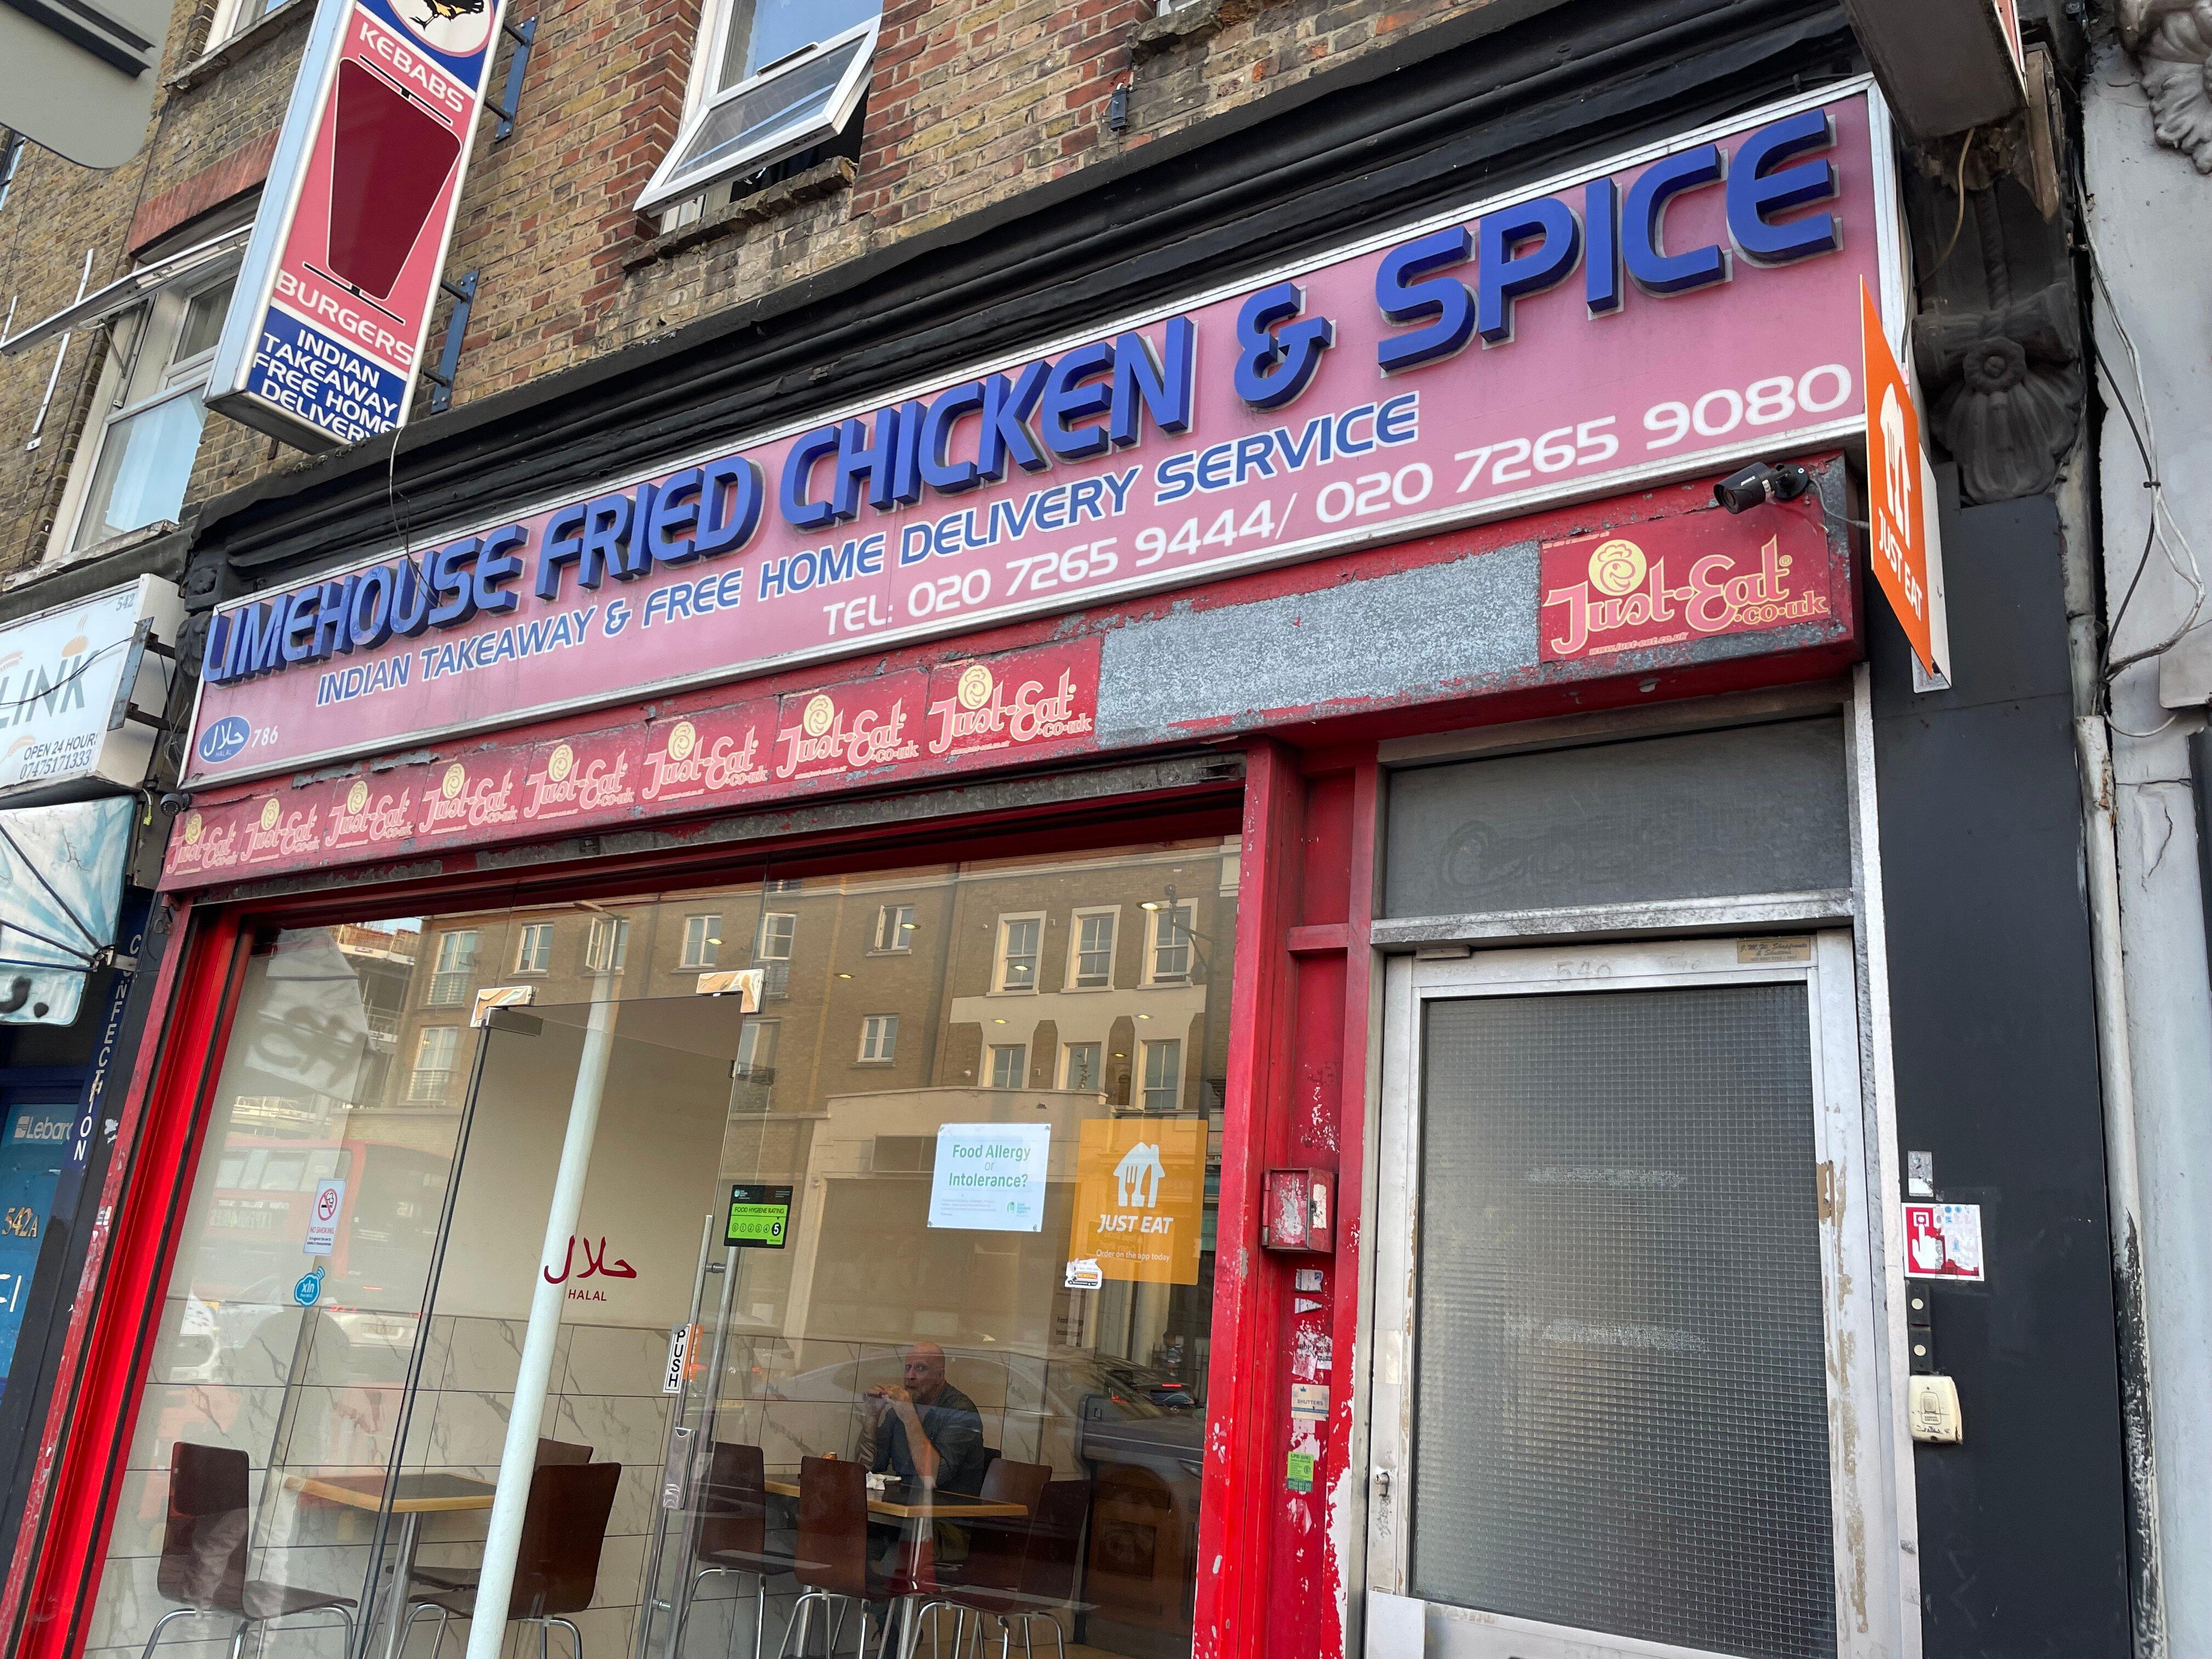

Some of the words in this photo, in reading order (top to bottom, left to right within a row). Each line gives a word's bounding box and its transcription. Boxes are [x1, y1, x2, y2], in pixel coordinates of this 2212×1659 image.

[359, 21, 464, 113] KEBABS
[275, 269, 414, 365] BURGERS
[297, 329, 380, 388] INDIAN
[264, 331, 398, 418] TAKEAWAY
[202, 524, 529, 684] LIMEHOUSE
[536, 456, 764, 600] FRIED
[780, 315, 1195, 530] CHICKEN
[1234, 281, 1334, 411] &
[1375, 109, 1839, 374] SPICE
[252, 356, 318, 399] FREE
[325, 390, 396, 433] HOME
[822, 598, 893, 636] TEL:
[907, 568, 990, 617] 020
[1006, 542, 1118, 596] 7265
[1316, 462, 1433, 524] 020
[1454, 416, 1618, 494] 7265
[1644, 363, 1852, 450] 9080
[316, 662, 410, 706] INDIAN
[421, 606, 596, 680] TAKEAWAY
[604, 599, 631, 637] &
[641, 568, 743, 629] FREE
[758, 533, 884, 602] HOME
[899, 465, 1143, 569] DELIVERY
[1154, 391, 1420, 505] SERVICE
[1878, 507, 1903, 583] JUST
[1905, 571, 1923, 621] EAT
[116, 593, 135, 611] 542
[24, 744, 49, 760] OPEN
[52, 741, 63, 754] 24
[204, 721, 245, 757] حلال
[252, 725, 278, 748] 786
[20, 749, 92, 780] 07475171333
[215, 749, 232, 758] HALAL
[1556, 961, 1611, 979] 540
[74, 934, 142, 1161] CNFECTION
[952, 1144, 983, 1158] Food
[985, 1145, 1030, 1161] Allergy
[985, 1162, 995, 1171] or
[949, 1173, 1028, 1187] Intolerance?
[2, 1207, 39, 1237] 542A
[774, 1224, 779, 1234] 5
[1097, 1214, 1138, 1233] JUST
[1141, 1216, 1174, 1234] EAT
[544, 1234, 637, 1284] حلال
[1126, 1251, 1136, 1259] the
[1152, 1254, 1170, 1263] today
[568, 1289, 607, 1301] HALAL
[668, 1329, 686, 1388] PUSH
